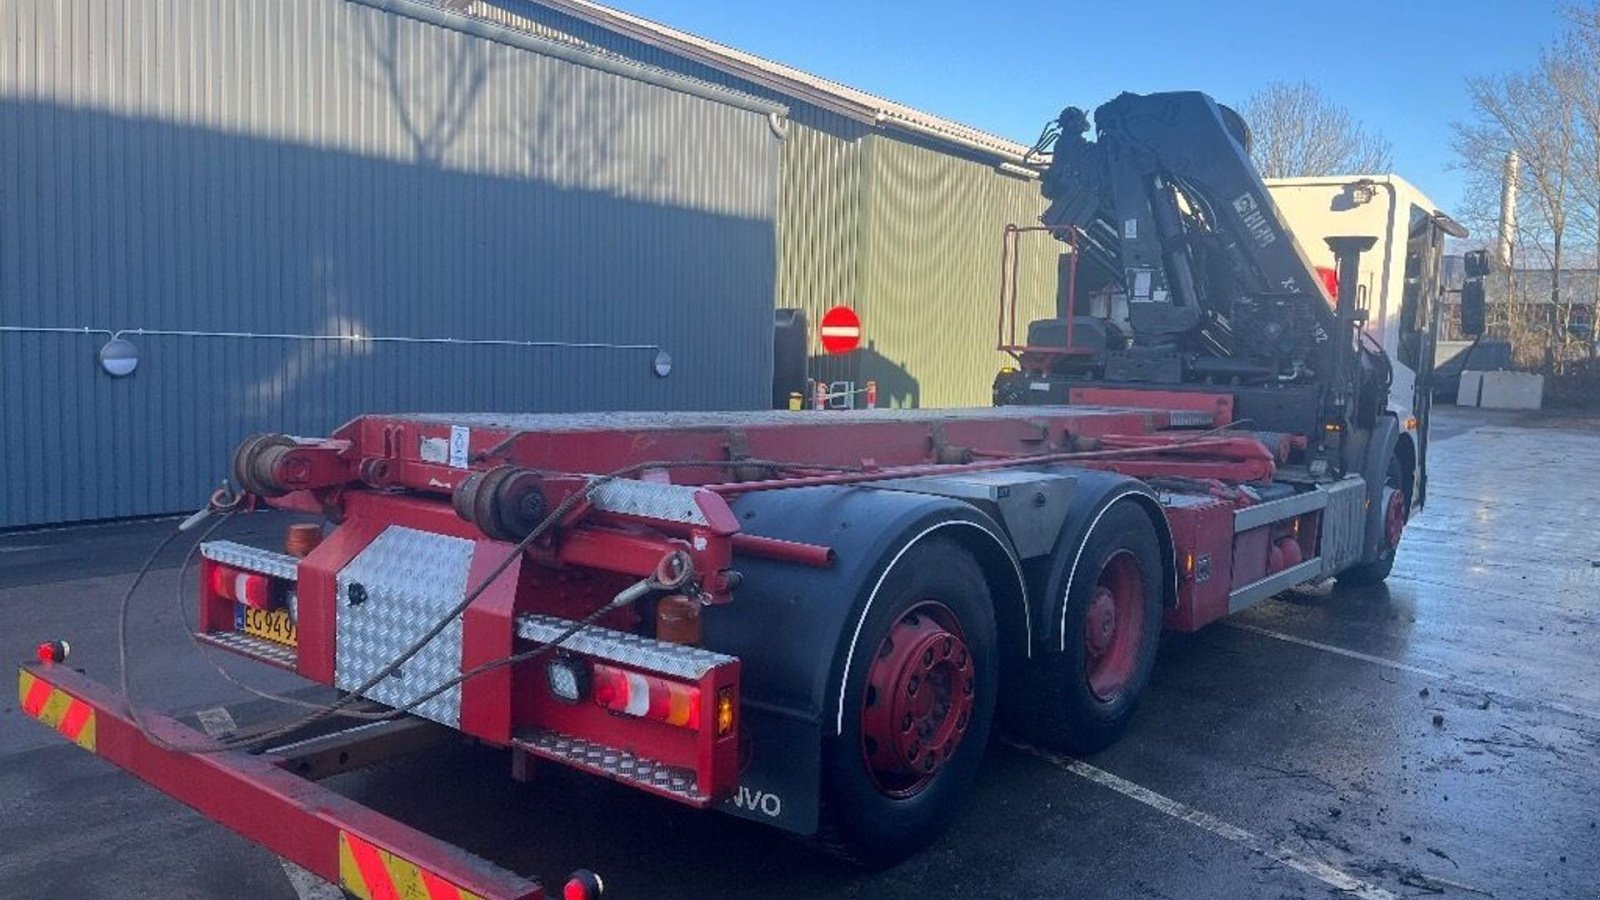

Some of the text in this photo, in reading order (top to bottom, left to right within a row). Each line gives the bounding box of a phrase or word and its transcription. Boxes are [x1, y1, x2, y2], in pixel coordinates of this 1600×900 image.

[245, 605, 262, 631] EG
[265, 611, 281, 637] 94
[284, 615, 298, 642] 9
